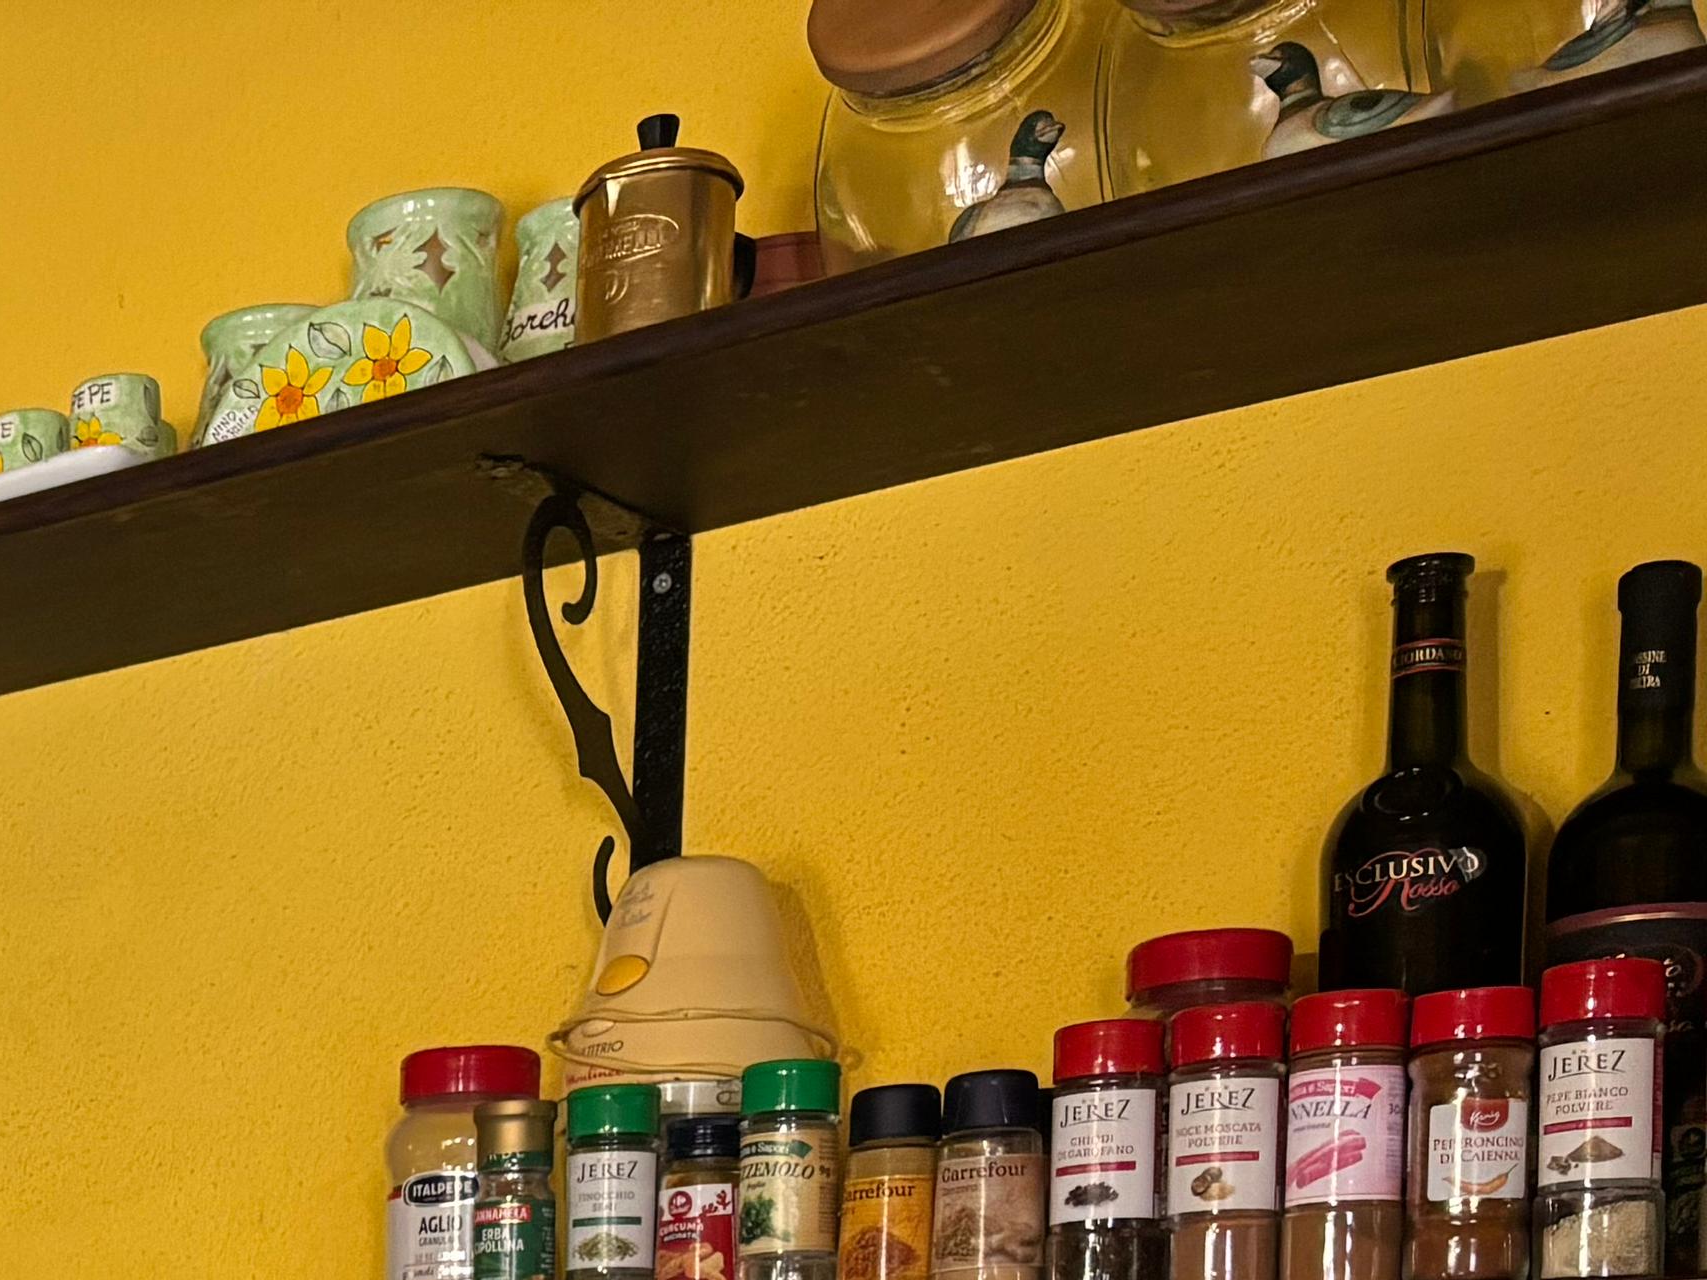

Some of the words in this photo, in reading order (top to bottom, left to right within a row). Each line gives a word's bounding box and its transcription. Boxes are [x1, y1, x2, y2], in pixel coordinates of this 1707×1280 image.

[1332, 847, 1480, 893] ESCLUSIVO
[1547, 1049, 1627, 1083] JEREZ
[1181, 1087, 1256, 1116] JEREZ
[1574, 1086, 1629, 1101] BIANCO
[1060, 1098, 1132, 1128] JEREZ
[1555, 1100, 1615, 1116] POLVERE
[1204, 1121, 1262, 1135] MOSCATA
[1187, 1134, 1244, 1149] POLVERE
[576, 1160, 639, 1184] JEREZ
[941, 1161, 1028, 1184] Carrefour
[412, 1180, 474, 1198] ITALPEPE
[418, 1215, 463, 1236] AGLIO
